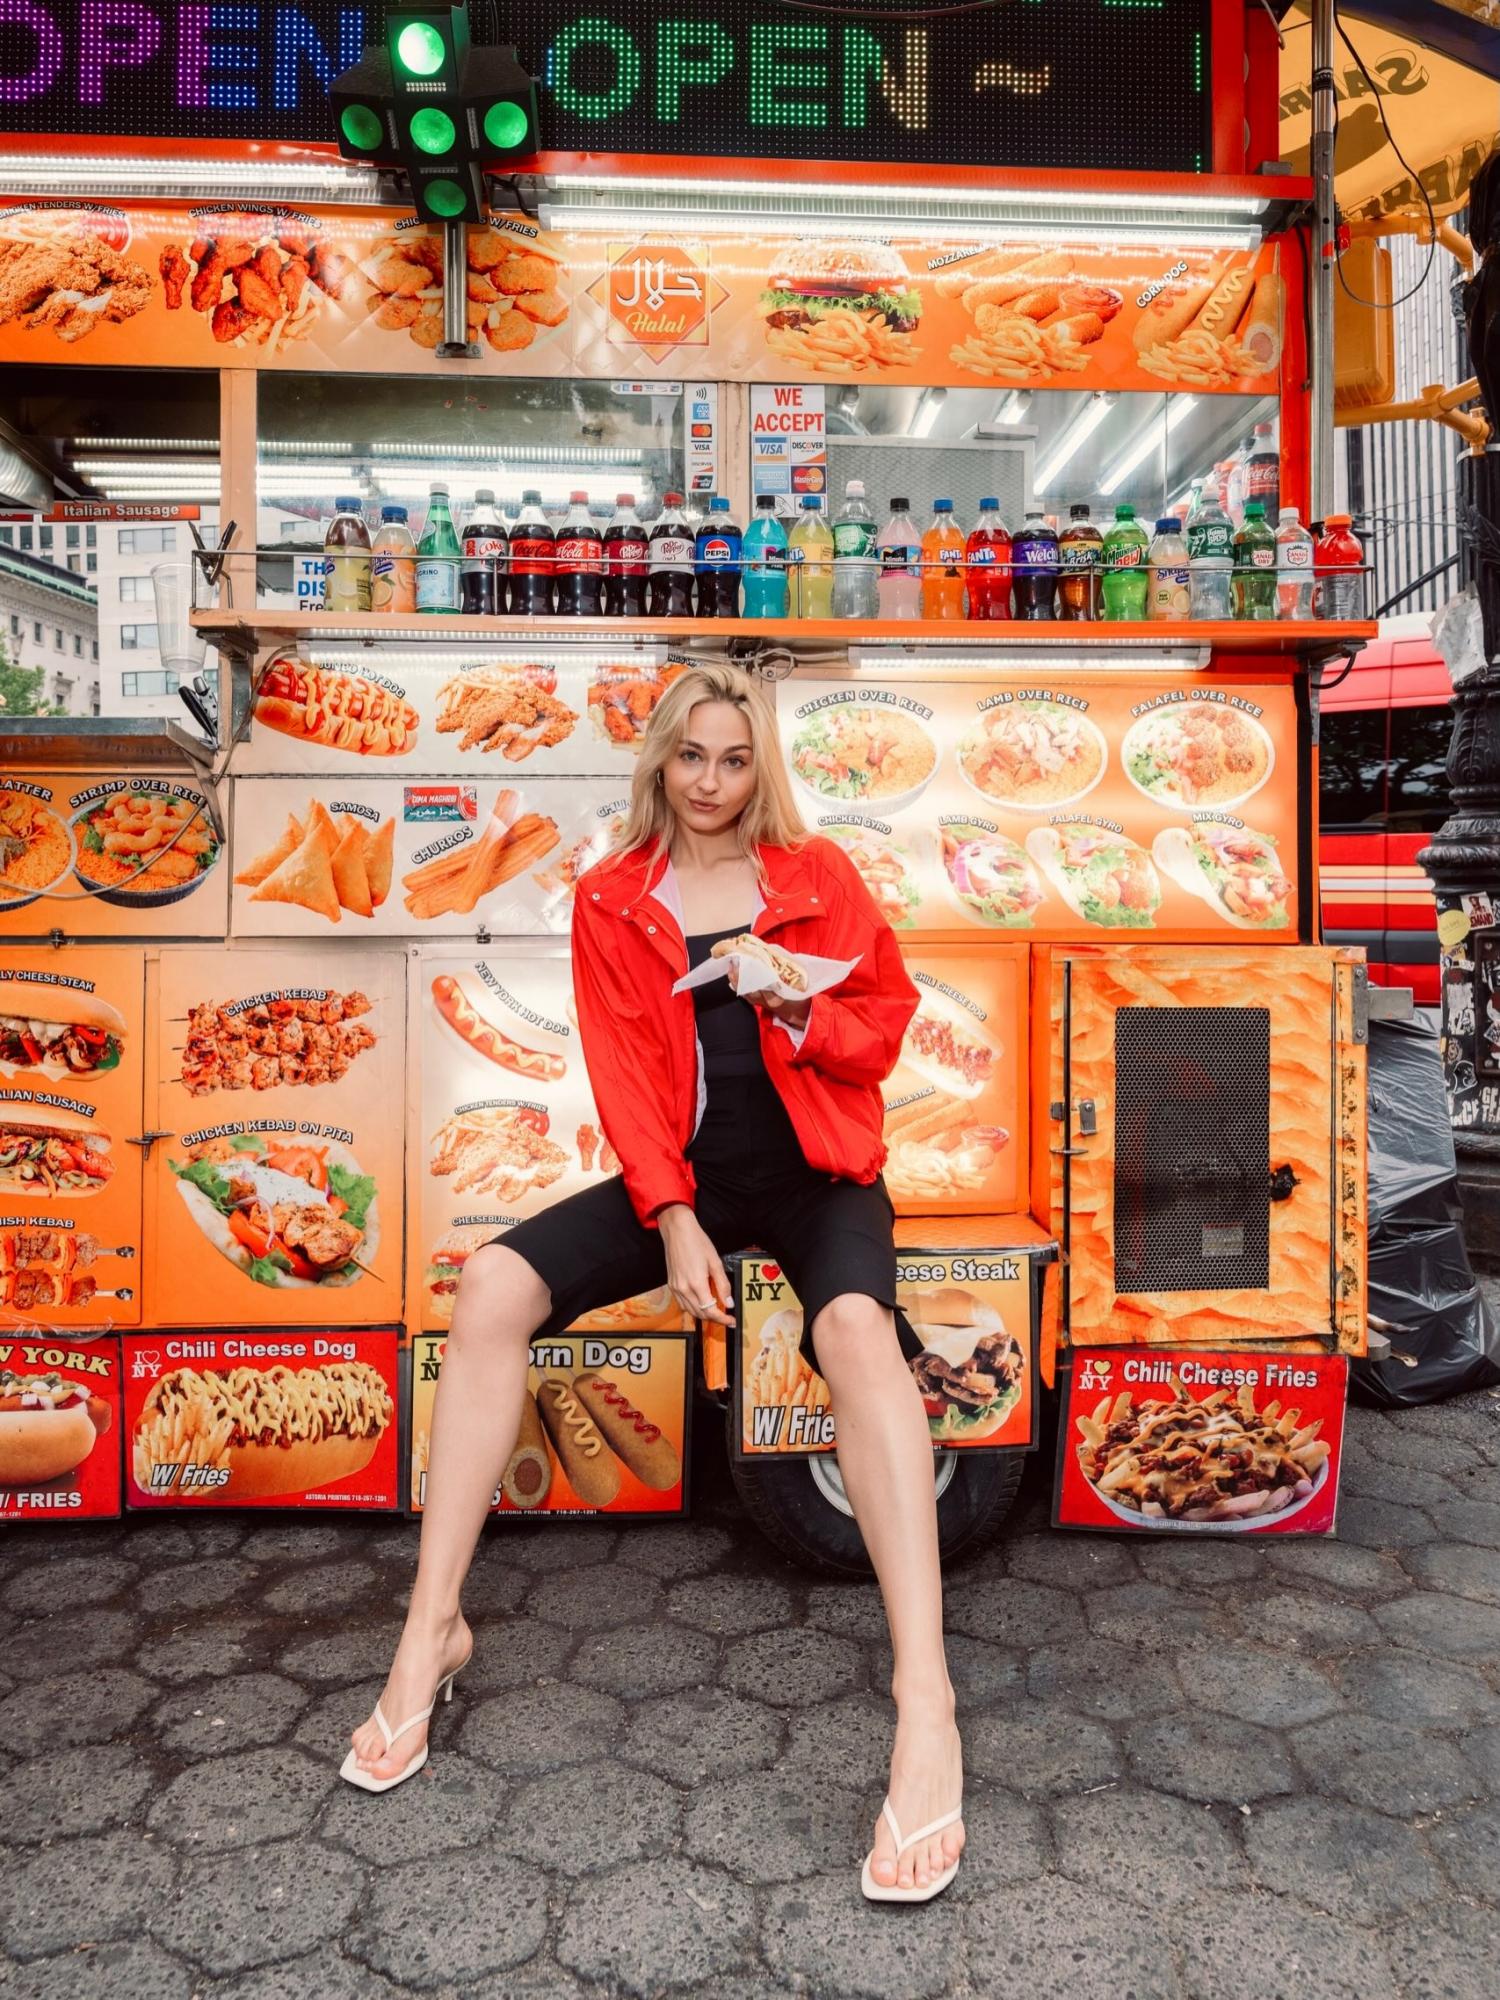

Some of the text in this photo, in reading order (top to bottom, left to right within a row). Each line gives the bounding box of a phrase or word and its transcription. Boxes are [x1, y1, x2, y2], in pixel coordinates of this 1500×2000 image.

[0, 2, 364, 108] OPEN
[548, 18, 930, 130] OPEN
[38, 201, 81, 210] TENDERS
[188, 204, 235, 218] CHICKEN
[237, 203, 273, 214] WINGS
[394, 216, 420, 231] CHIC
[1136, 260, 1189, 308] CORN DOG
[625, 312, 686, 333] Halal
[774, 387, 803, 406] WE
[754, 413, 825, 432] ACCEPT
[760, 444, 783, 455] VISA
[792, 441, 824, 449] DISCOVER
[64, 504, 180, 517] Italian Sausage
[789, 547, 804, 560] NTA
[967, 547, 996, 564] FANTA
[298, 581, 325, 597] DIS
[300, 600, 325, 611] Fre
[381, 678, 406, 700] DOG
[794, 690, 934, 720] CHICKEN OVER RICE
[976, 689, 1089, 712] LAMB OVER RICE
[1130, 689, 1263, 719] FALAFEL OVER RICE
[0, 779, 53, 801] ATTER
[70, 781, 126, 808] SHRIMP
[130, 778, 169, 793] OVER
[330, 802, 380, 822] SAMOSA
[1192, 812, 1244, 829] MIX GYRO
[818, 814, 892, 835] CHICKEN GYRO
[938, 814, 999, 833] LAMB GYRO
[1049, 815, 1123, 834] FALAFEL GYRO
[411, 826, 473, 864] CHURROS
[16, 970, 59, 984] CHEESE
[58, 976, 96, 993] STEAK
[225, 988, 328, 1017] CHICKEN KEBAB
[474, 960, 497, 988] NEW
[519, 1006, 544, 1026] HOT
[542, 1018, 570, 1036] DOG
[913, 971, 938, 988] CHILI
[967, 1002, 988, 1022] DOG
[34, 1092, 96, 1118] SAUSAGE
[181, 1119, 354, 1147] CHICKEN KEBAB ON PITA
[29, 1216, 75, 1228] KEBAB
[452, 1215, 525, 1227] CHEESEBURGE
[896, 1258, 1020, 1282] eese Steak
[746, 1283, 785, 1301] NY
[166, 1339, 357, 1360] Chili Cheese Dog
[583, 1340, 652, 1374] Dog
[21, 1346, 113, 1377] YORK
[131, 1364, 163, 1378] NY
[420, 1363, 440, 1381] N
[1077, 1375, 1113, 1391] NY
[1123, 1360, 1318, 1388] Chili Cheese Fries
[752, 1406, 837, 1447] W/ Frie
[150, 1463, 231, 1487] W/ Fries
[17, 1492, 82, 1508] FRIES
